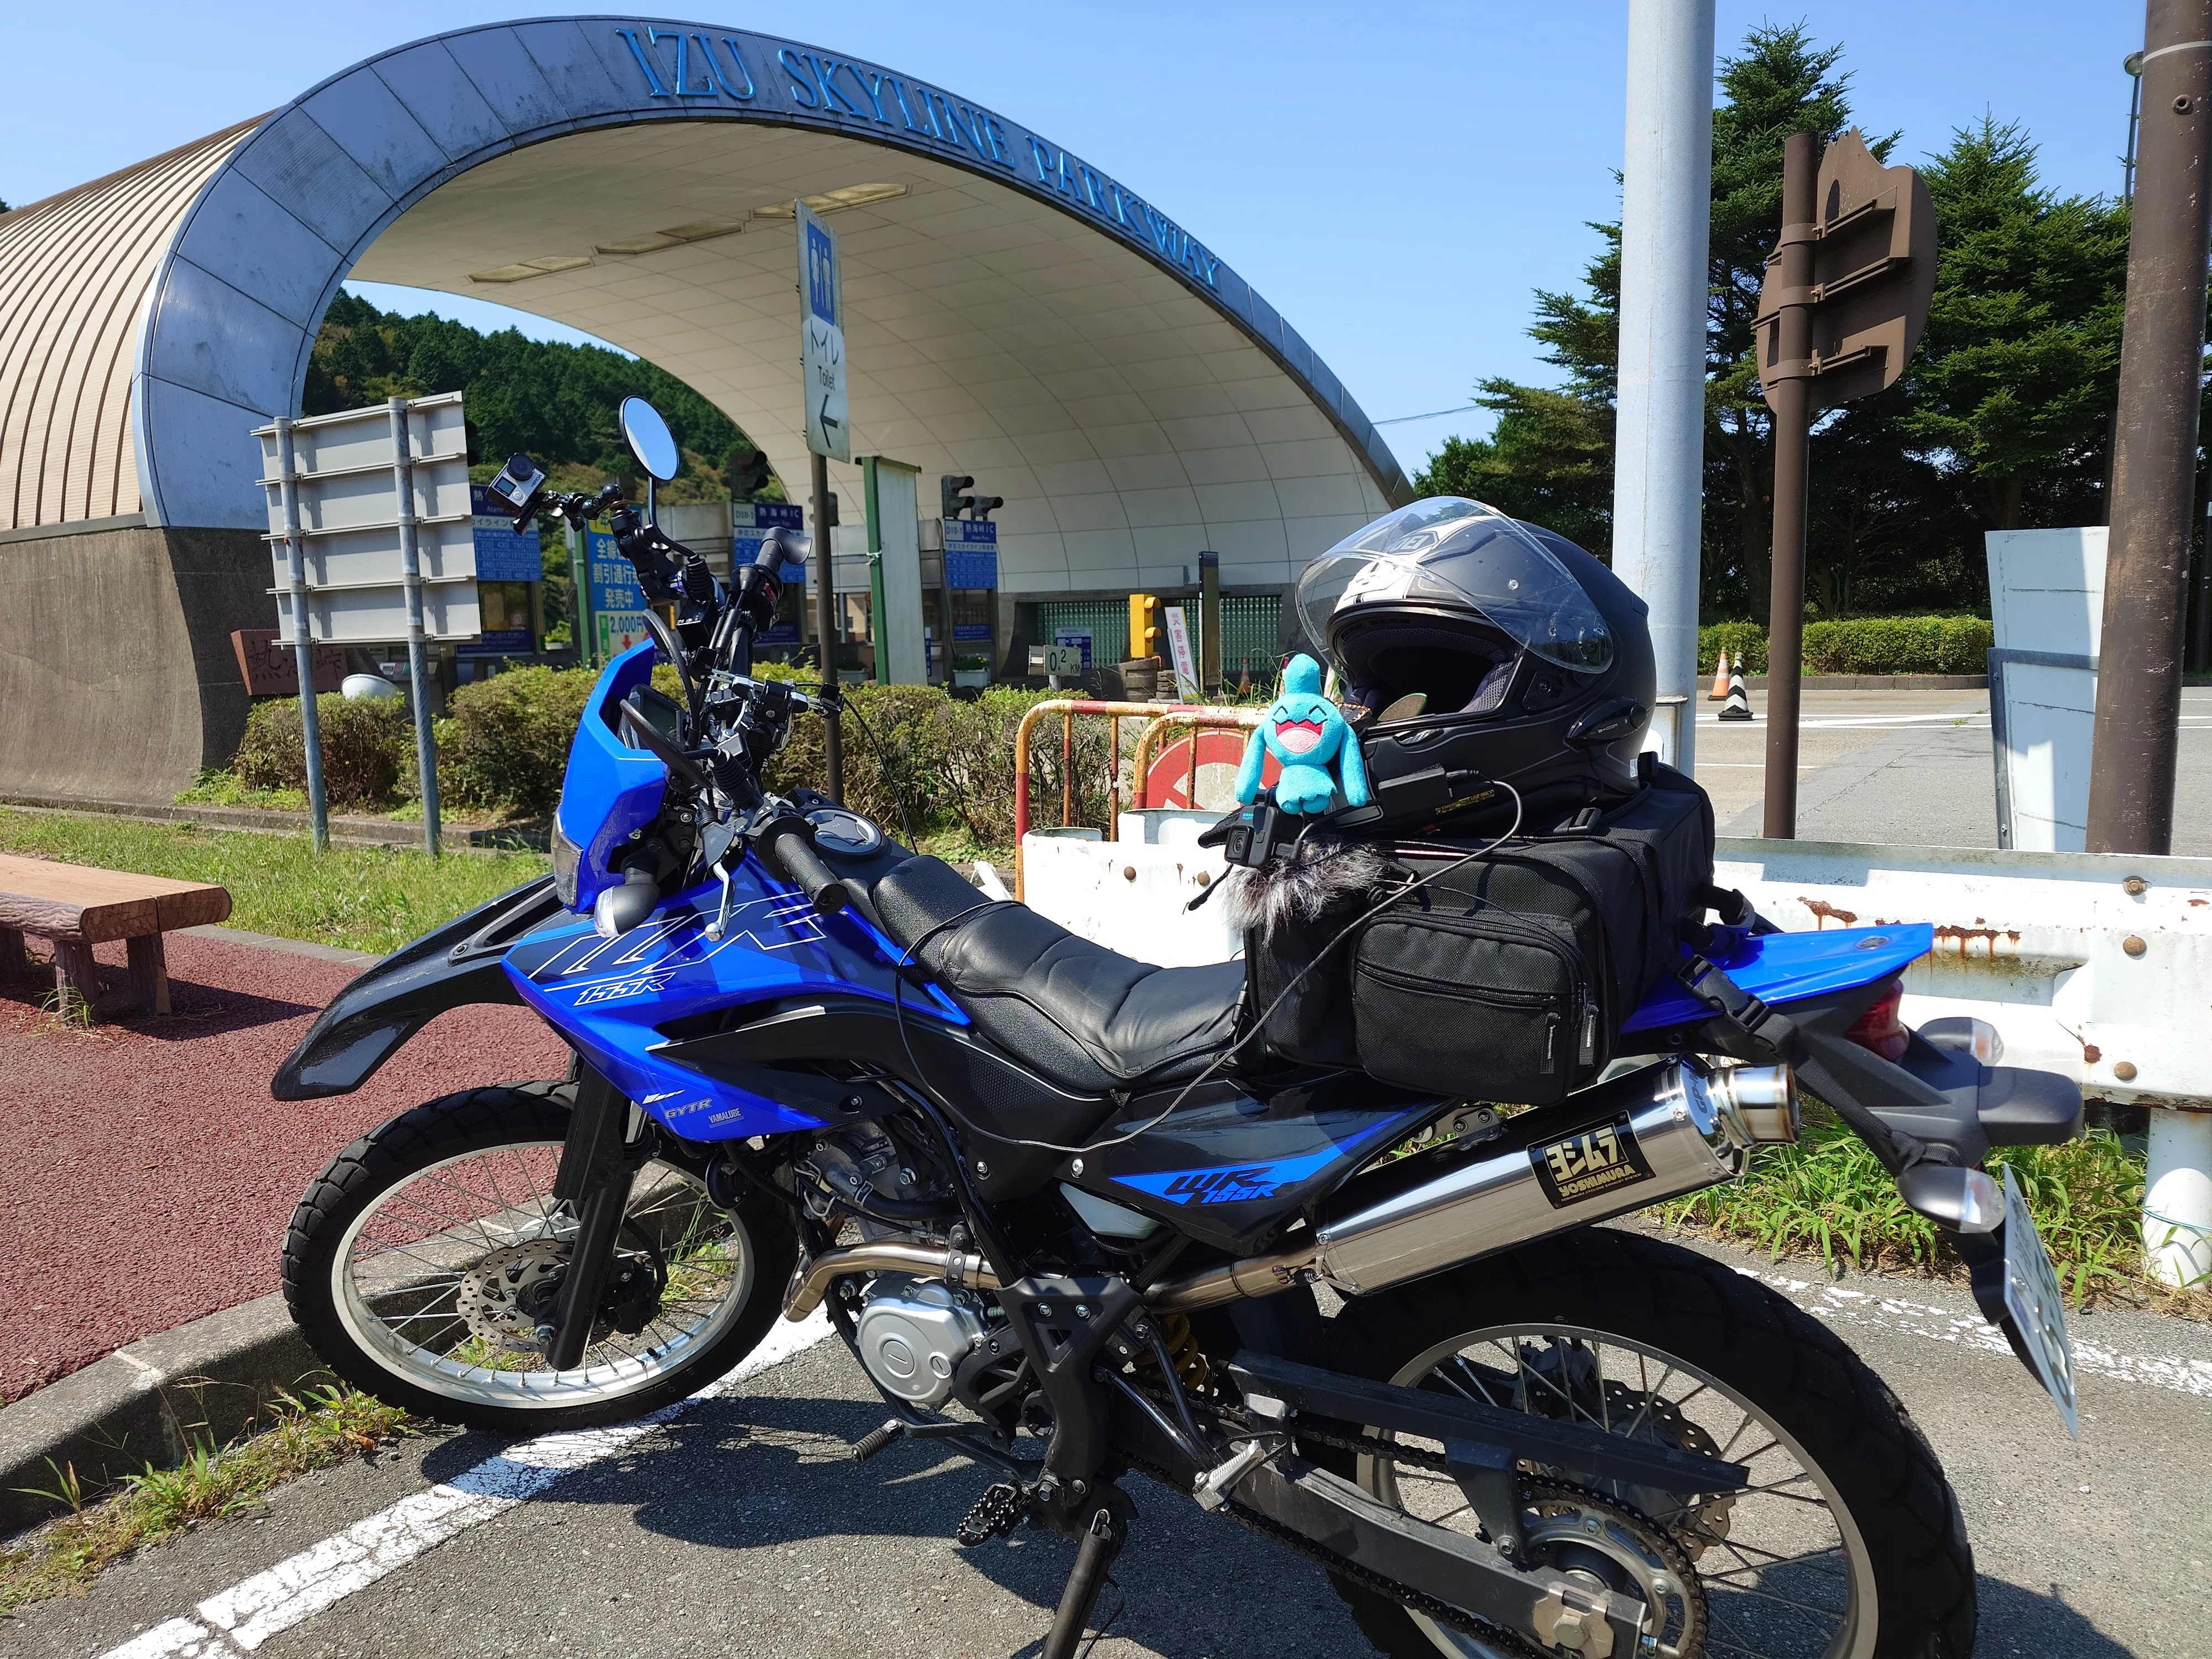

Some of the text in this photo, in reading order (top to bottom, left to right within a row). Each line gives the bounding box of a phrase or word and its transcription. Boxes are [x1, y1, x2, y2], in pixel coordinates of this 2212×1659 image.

[615, 25, 1220, 286] IZU SKYLINE PARKWAY
[810, 319, 839, 366] トイレ
[818, 366, 836, 391] Toilet
[605, 588, 634, 608] 発売中
[610, 615, 644, 634] 2,000円
[1172, 613, 1191, 687] 災害停電
[573, 971, 677, 1006] 155R
[665, 1098, 712, 1119] GYTR
[708, 1108, 742, 1124] YAMALUBE
[1546, 1126, 1619, 1182] ヨシムラ
[1201, 1183, 1274, 1204] 155R
[1558, 1164, 1636, 1197] YOSHIMURA
[1561, 1172, 1642, 1202] YOSHIMURA CYCLONE EXHAUST SYSTEM
